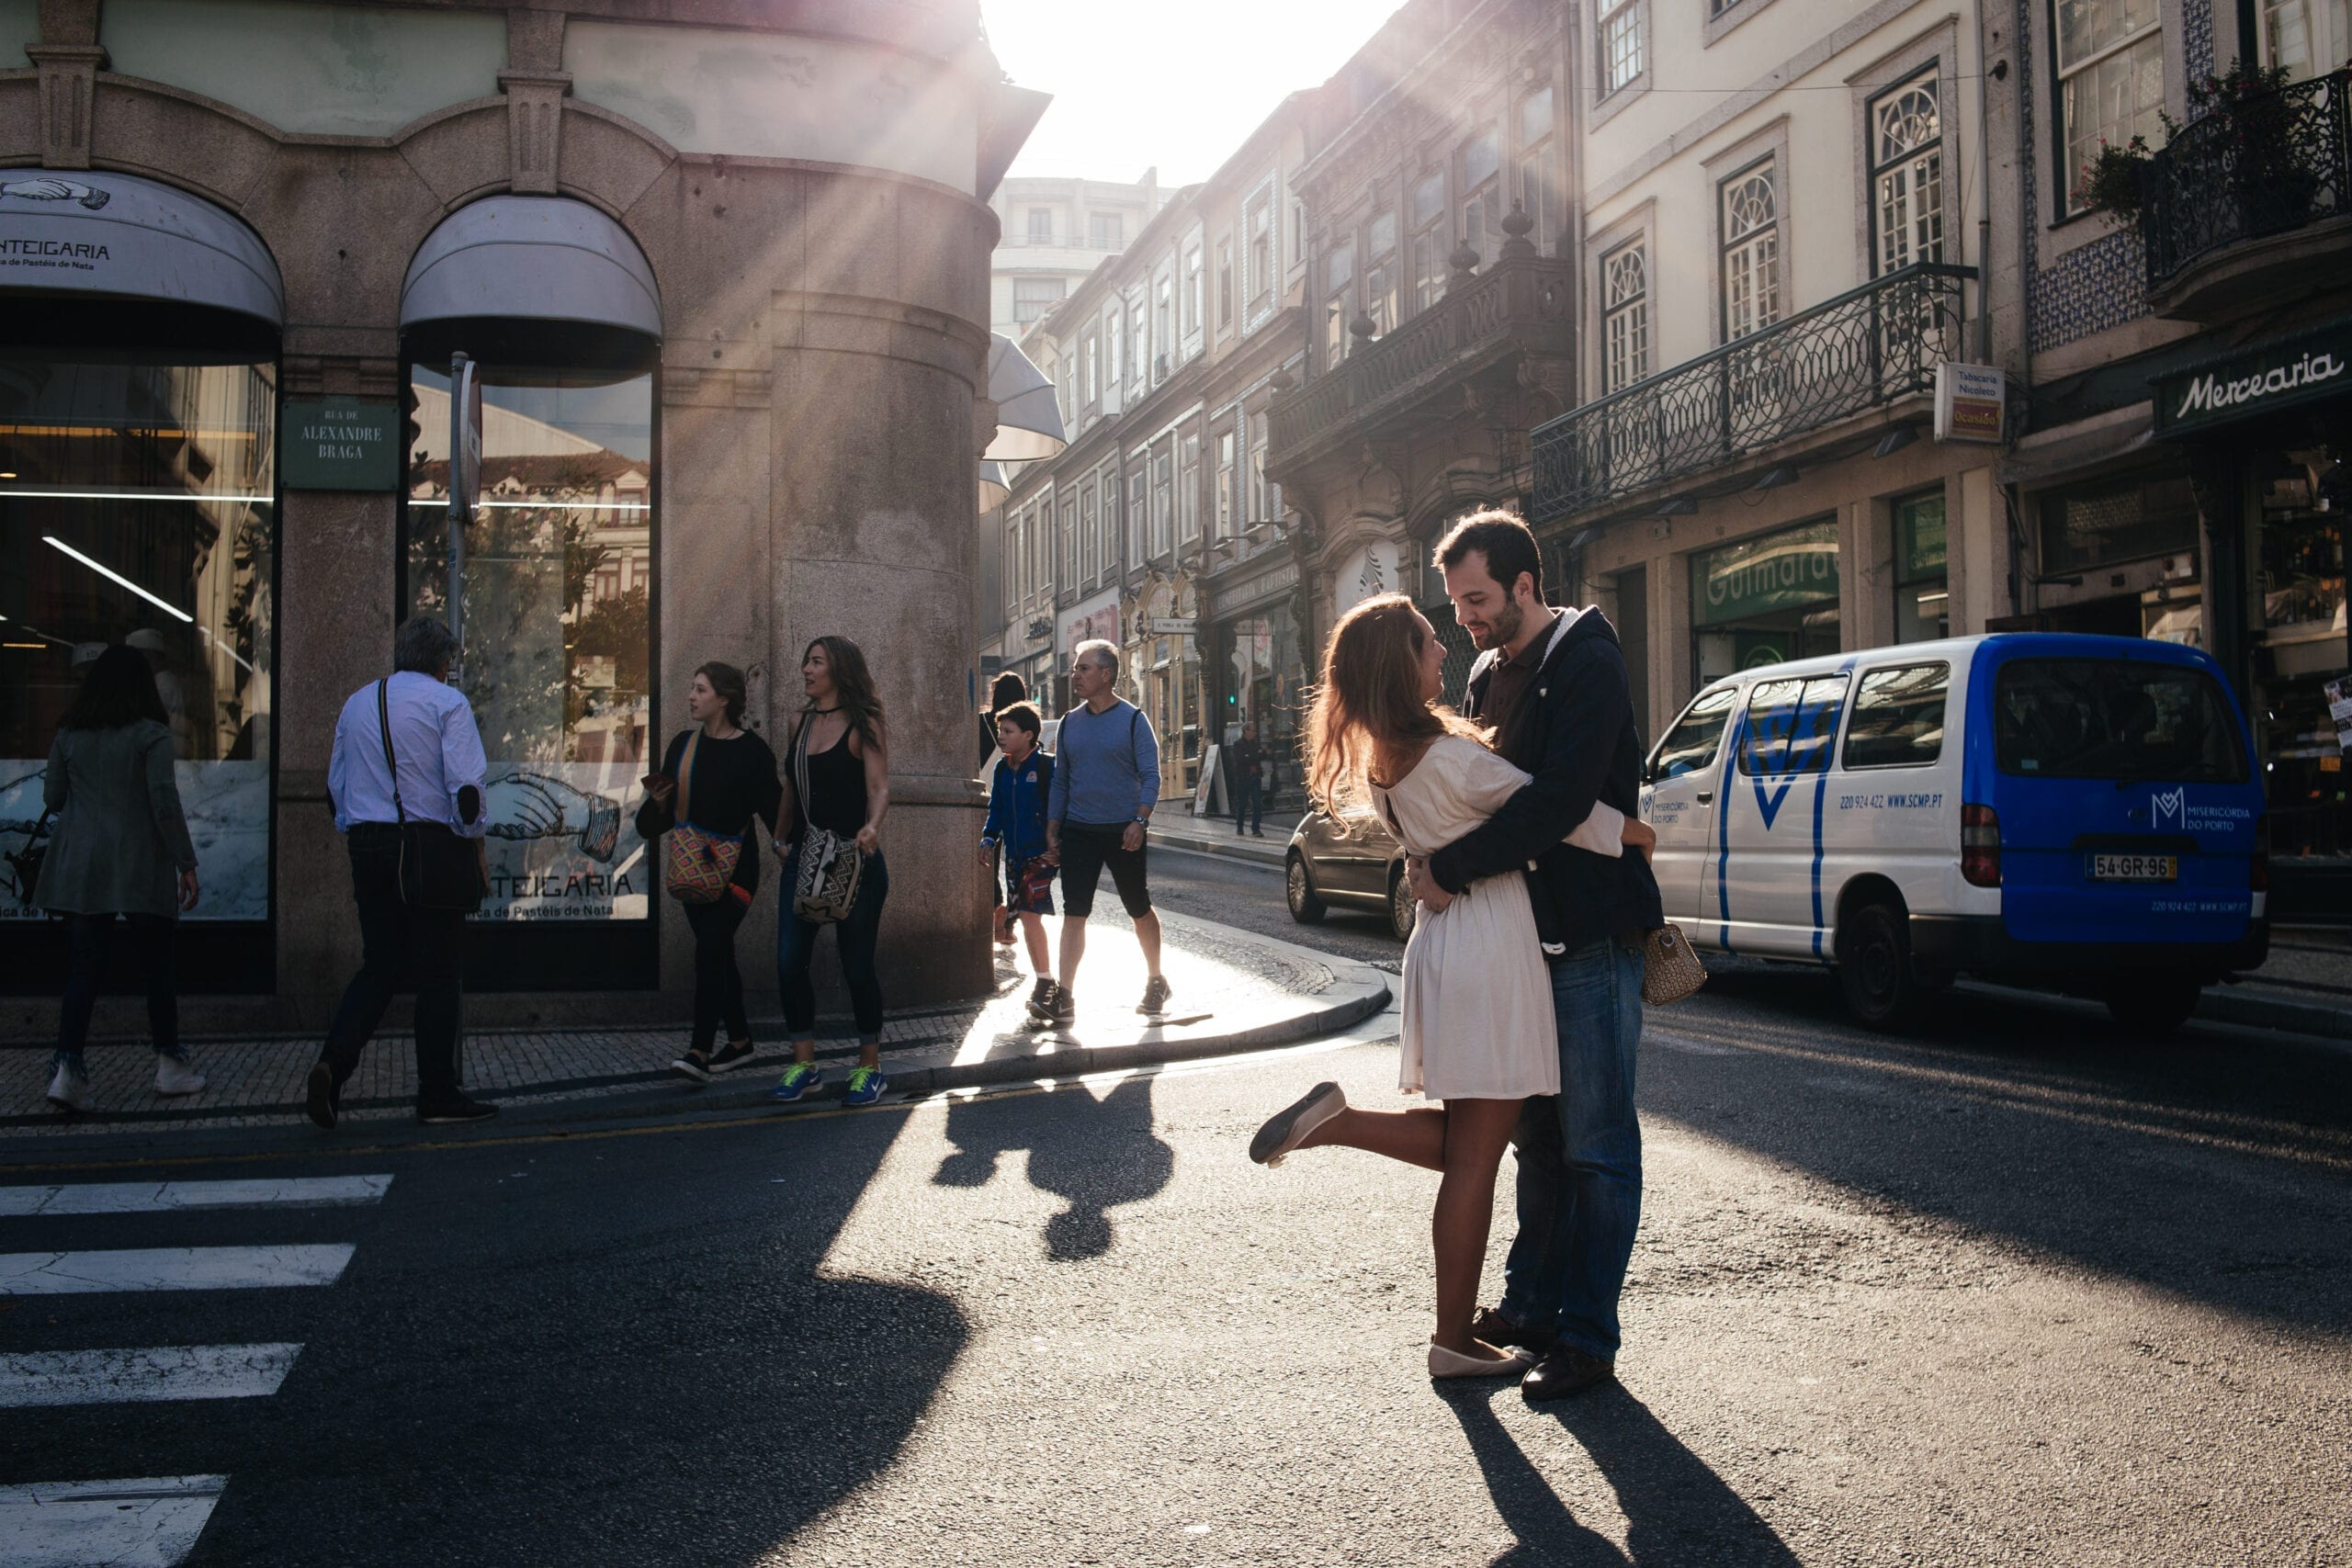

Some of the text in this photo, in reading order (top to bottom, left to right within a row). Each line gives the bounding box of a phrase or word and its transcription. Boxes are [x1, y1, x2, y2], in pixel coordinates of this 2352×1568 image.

[8, 258, 20, 266] de
[22, 258, 56, 267] Pastéis
[58, 260, 70, 268] de
[72, 261, 95, 270] Nata
[1958, 370, 1997, 384] Tabacaria
[2177, 352, 2345, 419] Mercearia
[324, 410, 359, 420] RUA DE
[301, 425, 382, 442] ALEXANDRE
[319, 445, 363, 459] BRAGA
[1840, 794, 1943, 809] 220 924 422 WWW.SCMP.PT
[2188, 819, 2234, 831] DO PORTO
[484, 874, 633, 897] TEIGARIA
[494, 906, 510, 917] de
[514, 904, 560, 917] Pastéis
[564, 905, 580, 916] de
[583, 904, 614, 915] Nata
[2152, 900, 2166, 911] 220
[2167, 900, 2181, 911] 924
